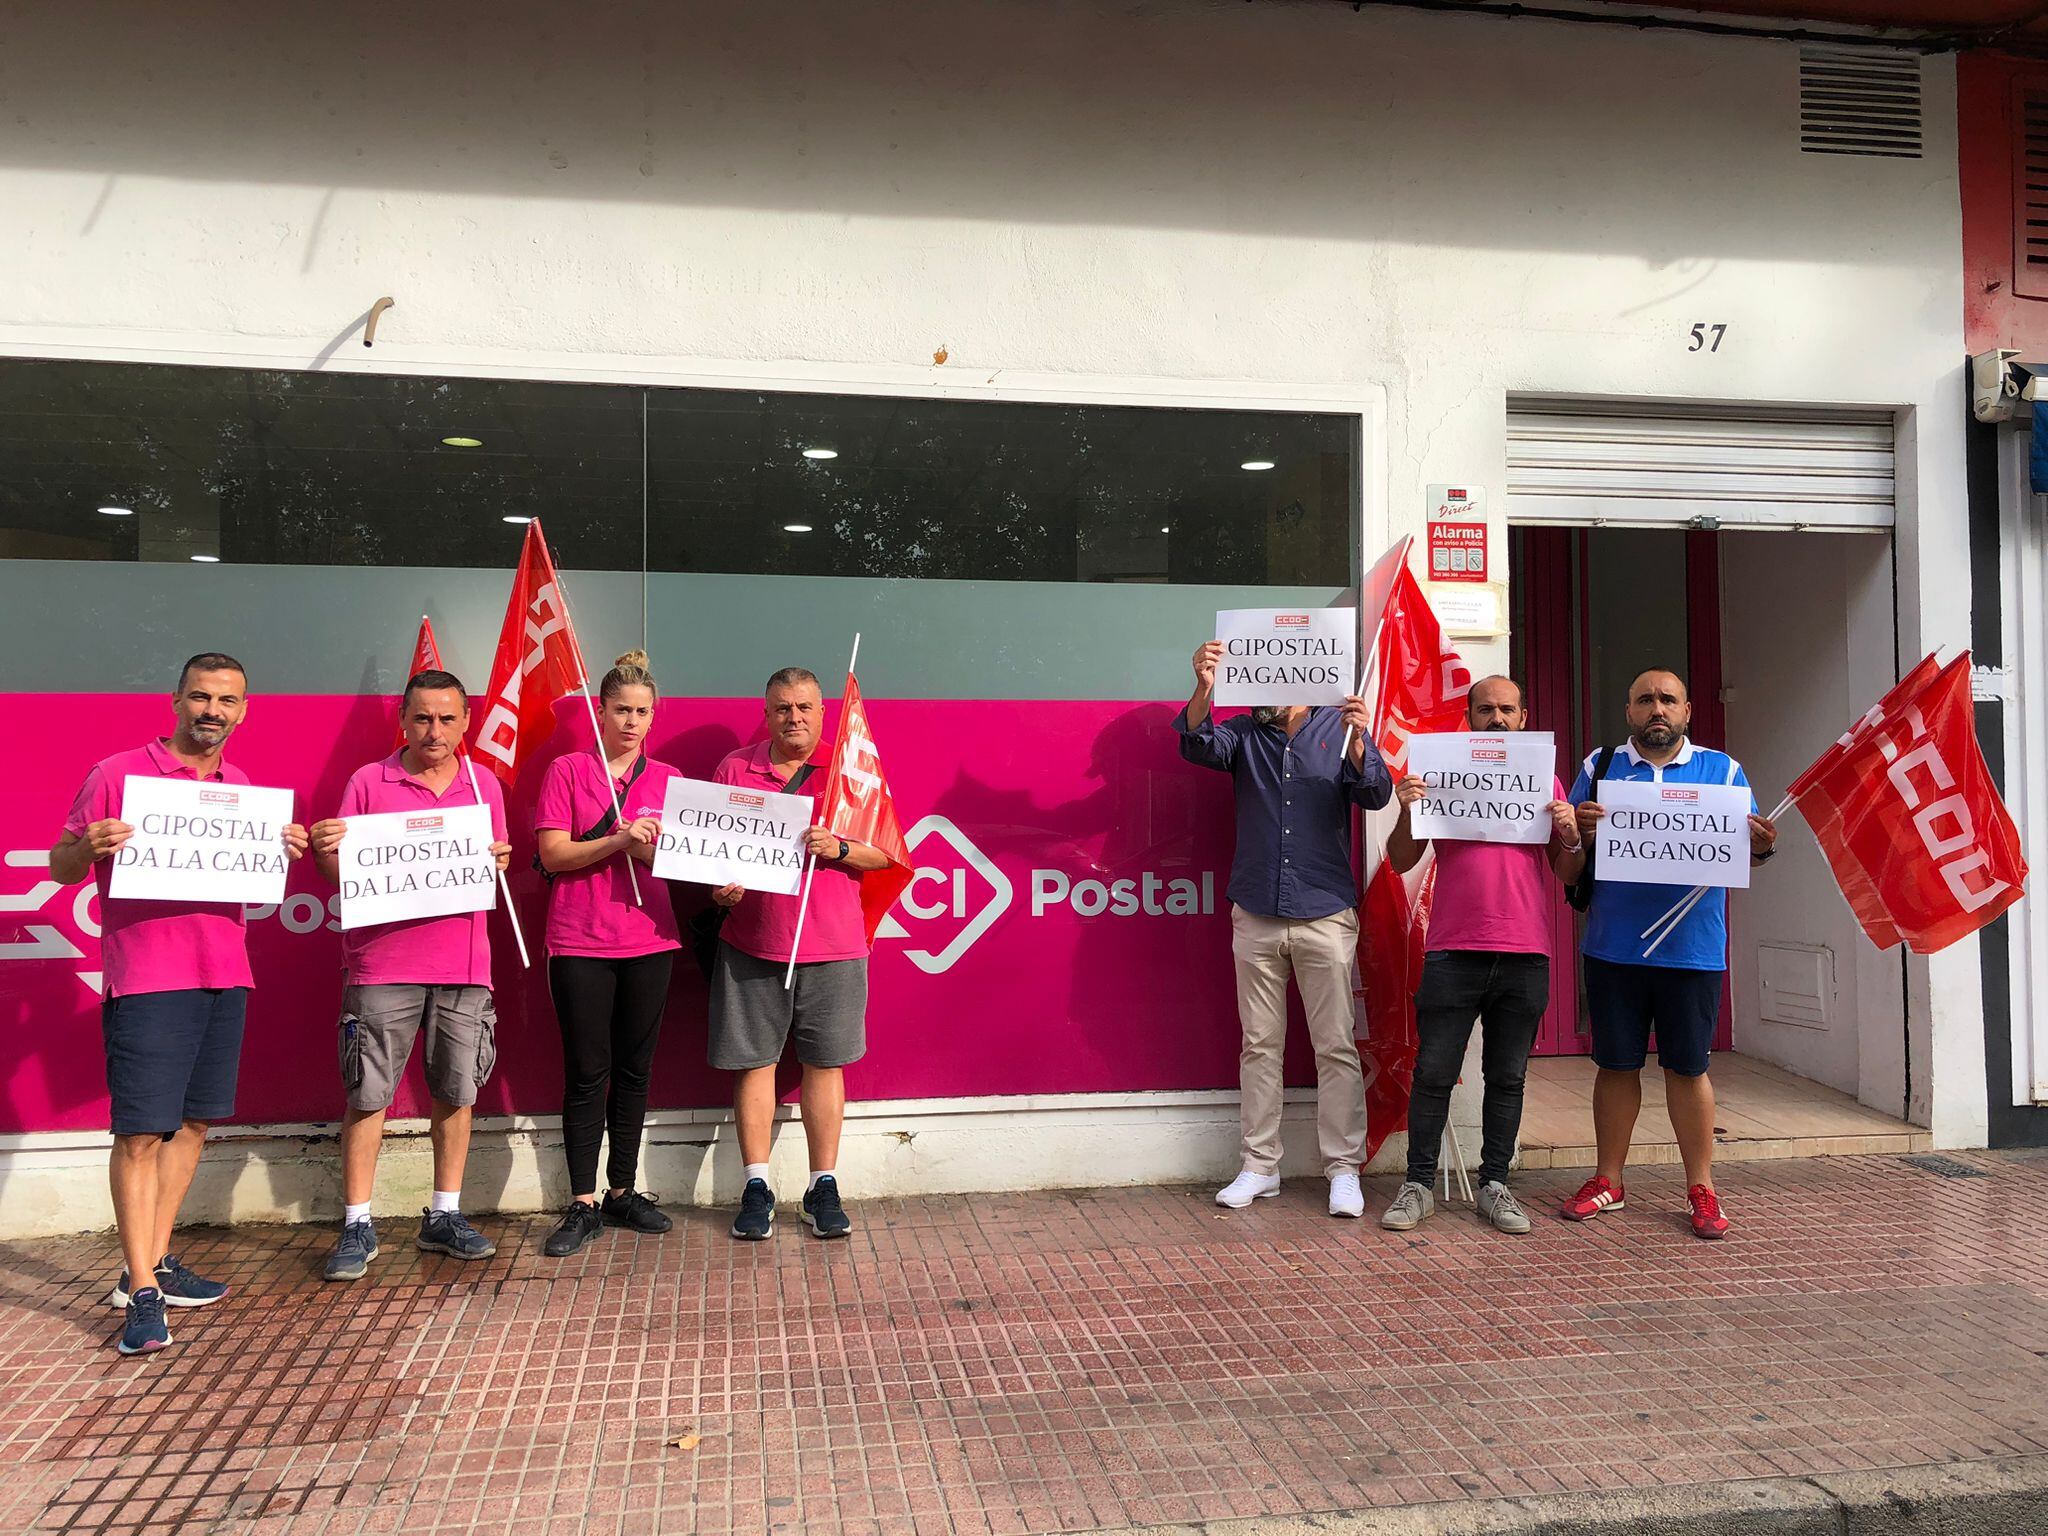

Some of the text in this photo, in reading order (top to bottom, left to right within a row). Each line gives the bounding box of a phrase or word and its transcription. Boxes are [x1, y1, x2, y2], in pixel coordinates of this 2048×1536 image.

[1688, 323, 1727, 352] 57
[1439, 502, 1478, 518] Direct
[1433, 525, 1483, 539] Alarma
[1276, 616, 1301, 624] CCOO
[1228, 638, 1344, 656] CIPOSTAL
[1225, 666, 1339, 684] PAGANOS
[1422, 771, 1541, 793] CIPOSTAL
[731, 793, 757, 804] CCOO
[1663, 791, 1690, 799] CCOO
[1420, 798, 1535, 821] PAGANOS
[142, 813, 274, 842] CIPOSTAL
[408, 817, 435, 828] CCOO
[679, 808, 792, 840] CIPOSTAL
[1610, 811, 1737, 834] CIPOSTAL
[116, 845, 286, 874] DA LA CARA
[357, 837, 479, 867] CIPOSTAL
[659, 833, 801, 869] DA LA CARA
[1607, 839, 1731, 863] PAGANOS
[343, 865, 494, 900] DA LA CARA
[900, 867, 1215, 919] CI Postal
